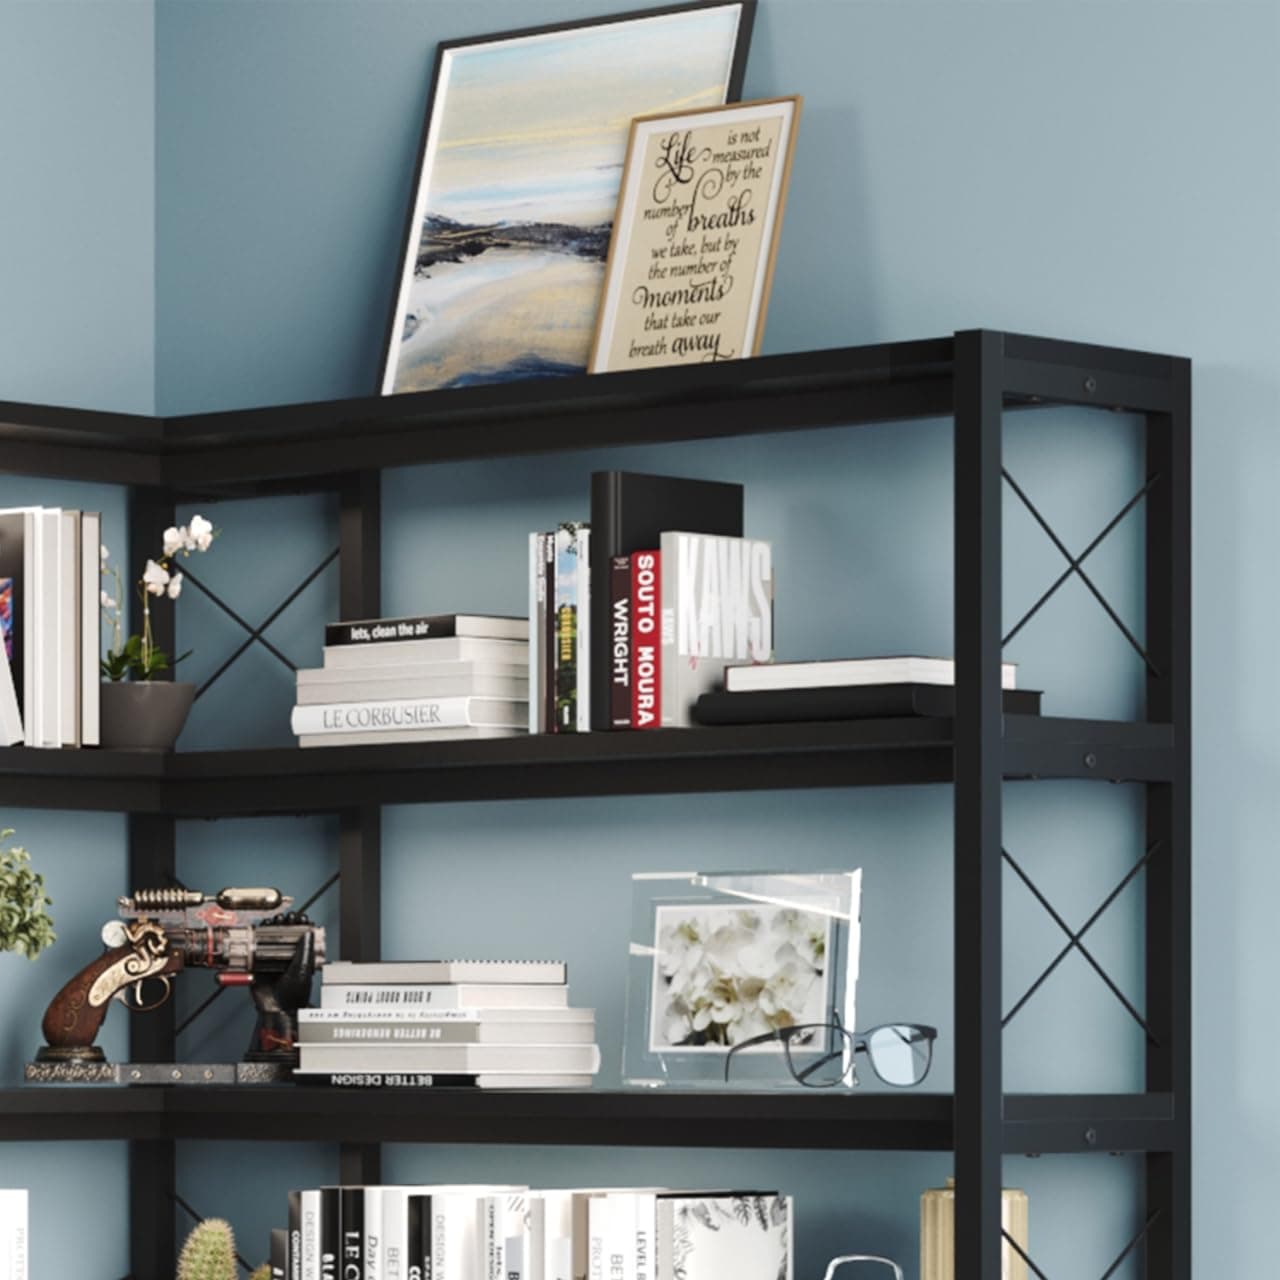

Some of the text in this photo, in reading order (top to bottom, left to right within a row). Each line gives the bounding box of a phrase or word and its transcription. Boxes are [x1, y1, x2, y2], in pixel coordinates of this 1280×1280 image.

[727, 126, 761, 145] is not
[654, 131, 702, 193] Life
[712, 138, 772, 163] measured
[726, 161, 763, 186] by the
[644, 200, 692, 220] number
[666, 182, 755, 242] of breaths
[651, 245, 667, 259] we
[700, 239, 721, 255] but
[723, 233, 740, 252] by
[648, 252, 736, 280] the number of
[632, 276, 733, 308] moments
[644, 309, 721, 331] that take our
[629, 332, 724, 360] breath away
[637, 553, 654, 634] SOUTO
[678, 536, 772, 662] KAWS
[372, 622, 397, 639] clean
[398, 621, 414, 637] the
[415, 620, 430, 635] air
[614, 598, 629, 687] WRIGHT
[637, 646, 654, 726] MOURA
[323, 703, 442, 729] LE CORBUSIER
[331, 1074, 433, 1087] BETTER DESIGN
[305, 1211, 315, 1262] DESIGN
[344, 1231, 360, 1259] LE
[435, 1215, 445, 1267] DESIGN
[636, 1230, 647, 1268] LEVEL
[368, 1235, 378, 1270] Day
